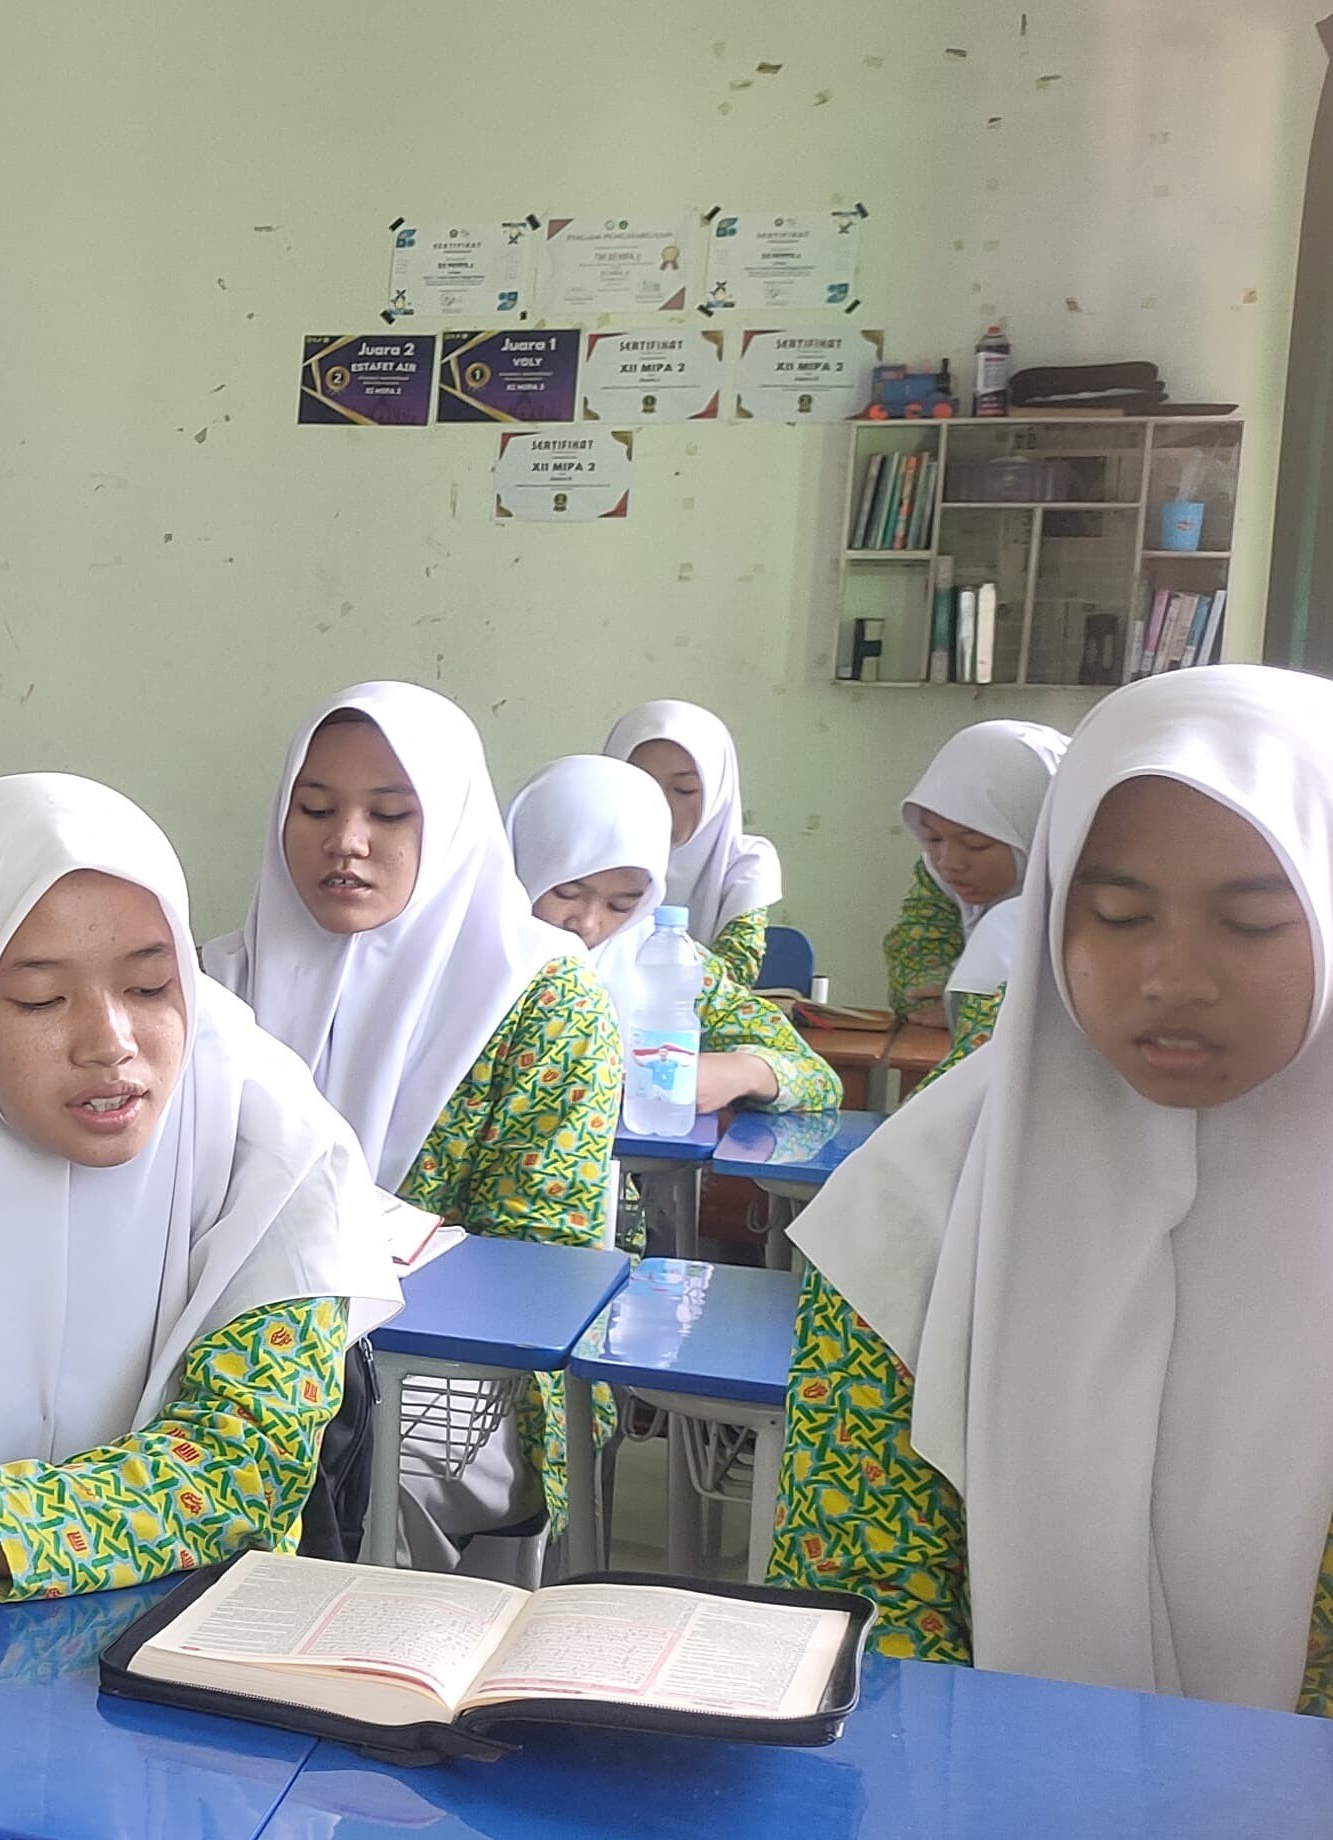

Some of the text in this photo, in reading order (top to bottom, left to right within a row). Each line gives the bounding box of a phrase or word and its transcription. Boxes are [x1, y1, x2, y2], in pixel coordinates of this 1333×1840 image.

[358, 342, 415, 356] Juara 2
[501, 337, 556, 351] Juara 1
[619, 340, 683, 351] SERTIFIKAT
[775, 338, 842, 349] SERTIFIKAT
[351, 361, 417, 372] ESTAFET AIR
[512, 357, 543, 367] VOLY
[619, 362, 686, 373] XII MIPA 2
[798, 362, 831, 371] MIPA
[836, 362, 844, 372] 2
[333, 373, 342, 384] 2
[531, 440, 594, 450] SERTIFIKAT
[531, 462, 596, 472] XII MIPA 2
